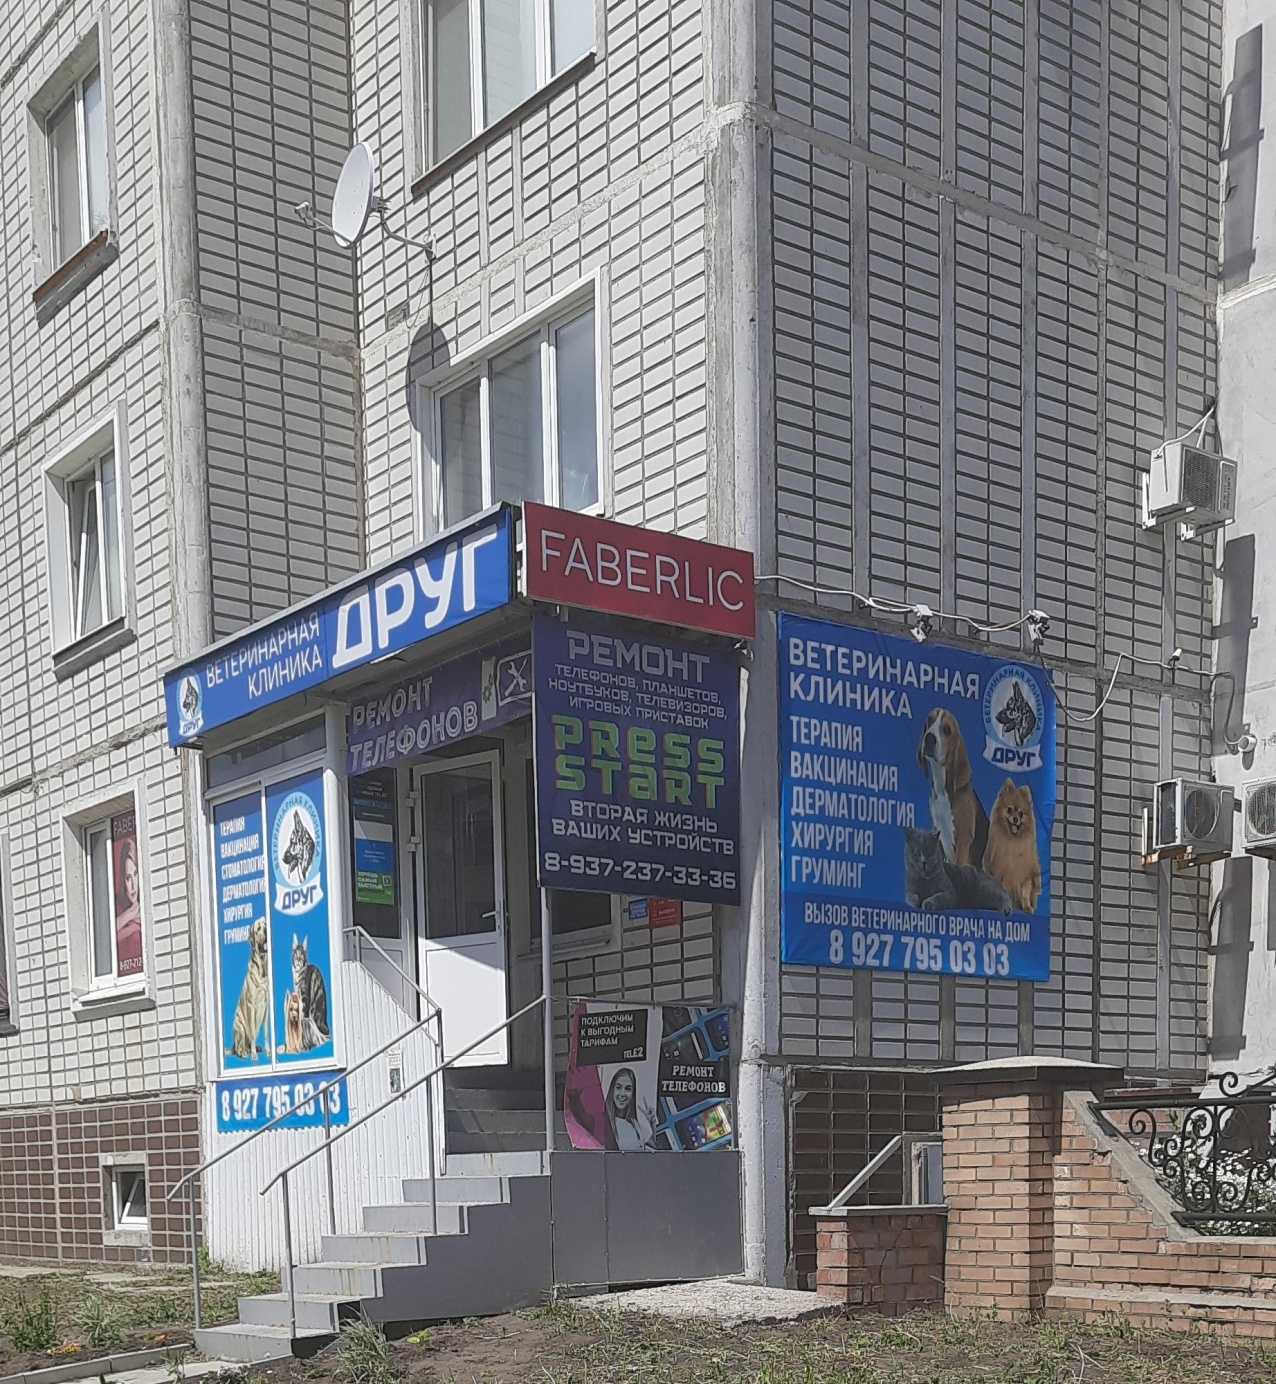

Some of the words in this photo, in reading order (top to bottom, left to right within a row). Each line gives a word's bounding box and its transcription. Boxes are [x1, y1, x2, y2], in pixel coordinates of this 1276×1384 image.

[541, 528, 744, 611] FABERLIC
[332, 524, 497, 668] ДРУГ
[206, 612, 321, 689] ВЕТЕРИНАРНАЯ
[566, 630, 710, 683] РЕМОНТ
[788, 637, 980, 700] ВЕТЕРИНАРНАЯ
[248, 646, 322, 699] КЛИНИКА
[555, 663, 639, 690] ТЕЛЕФОНОВ,
[642, 679, 721, 706] ПЛАНШЕТОВ,
[352, 676, 433, 734] РЕМОНТ
[548, 677, 632, 703] НОУТБУКОВ,
[636, 692, 728, 720] ТЕЛЕВИЗОРОВ,
[569, 695, 632, 717] ИГРОВЫХ
[636, 706, 710, 729] ПРИСТАВОК
[789, 671, 913, 720] КЛИНИКА
[350, 700, 478, 772] ТЕЛЕФОНОВ
[789, 715, 863, 753] ТЕРАПИЯ
[790, 751, 899, 793] ВАКЦИНАЦИЯ
[992, 747, 1036, 768] ДРУГ
[569, 799, 648, 825] ВТОРАЯ
[654, 810, 718, 833] ЖИЗНЬ
[791, 786, 916, 828] ДЕРМАТОЛОГИЯ
[551, 818, 621, 842] ВАШИХ
[628, 827, 735, 856] УСТРОЙСТВ
[791, 821, 874, 856] ХИРУРГИЯ
[544, 851, 737, 889] 8-937-237-33-36
[791, 855, 866, 889] ГРУМИНГ
[282, 885, 317, 911] ДРУГ
[804, 902, 849, 928] ВЫЗОВ
[851, 906, 946, 935] ВЕТЕРИНАРНОГО
[949, 918, 985, 940] ВРАЧА
[988, 921, 1002, 941] НА
[1004, 921, 1031, 943] ДОМ
[829, 929, 844, 964] 8
[852, 931, 894, 968] 927
[901, 935, 943, 971] 795
[950, 940, 977, 975] 03
[983, 943, 1010, 976] 03
[581, 1028, 586, 1037] К
[588, 1024, 634, 1036] ВЫГОДНЫМ
[582, 1014, 633, 1026] ПОДКЛЮЧИМ
[581, 1037, 618, 1048] ТАРИФАМ
[623, 1047, 644, 1059] TELE2
[662, 1080, 727, 1093] ТЕЛЕФОНОВ
[672, 1065, 714, 1078] РЕМОНТ
[222, 1090, 230, 1121] 8
[233, 1088, 259, 1121] 927
[263, 1084, 290, 1119] 795
[294, 1082, 315, 1116] 03
